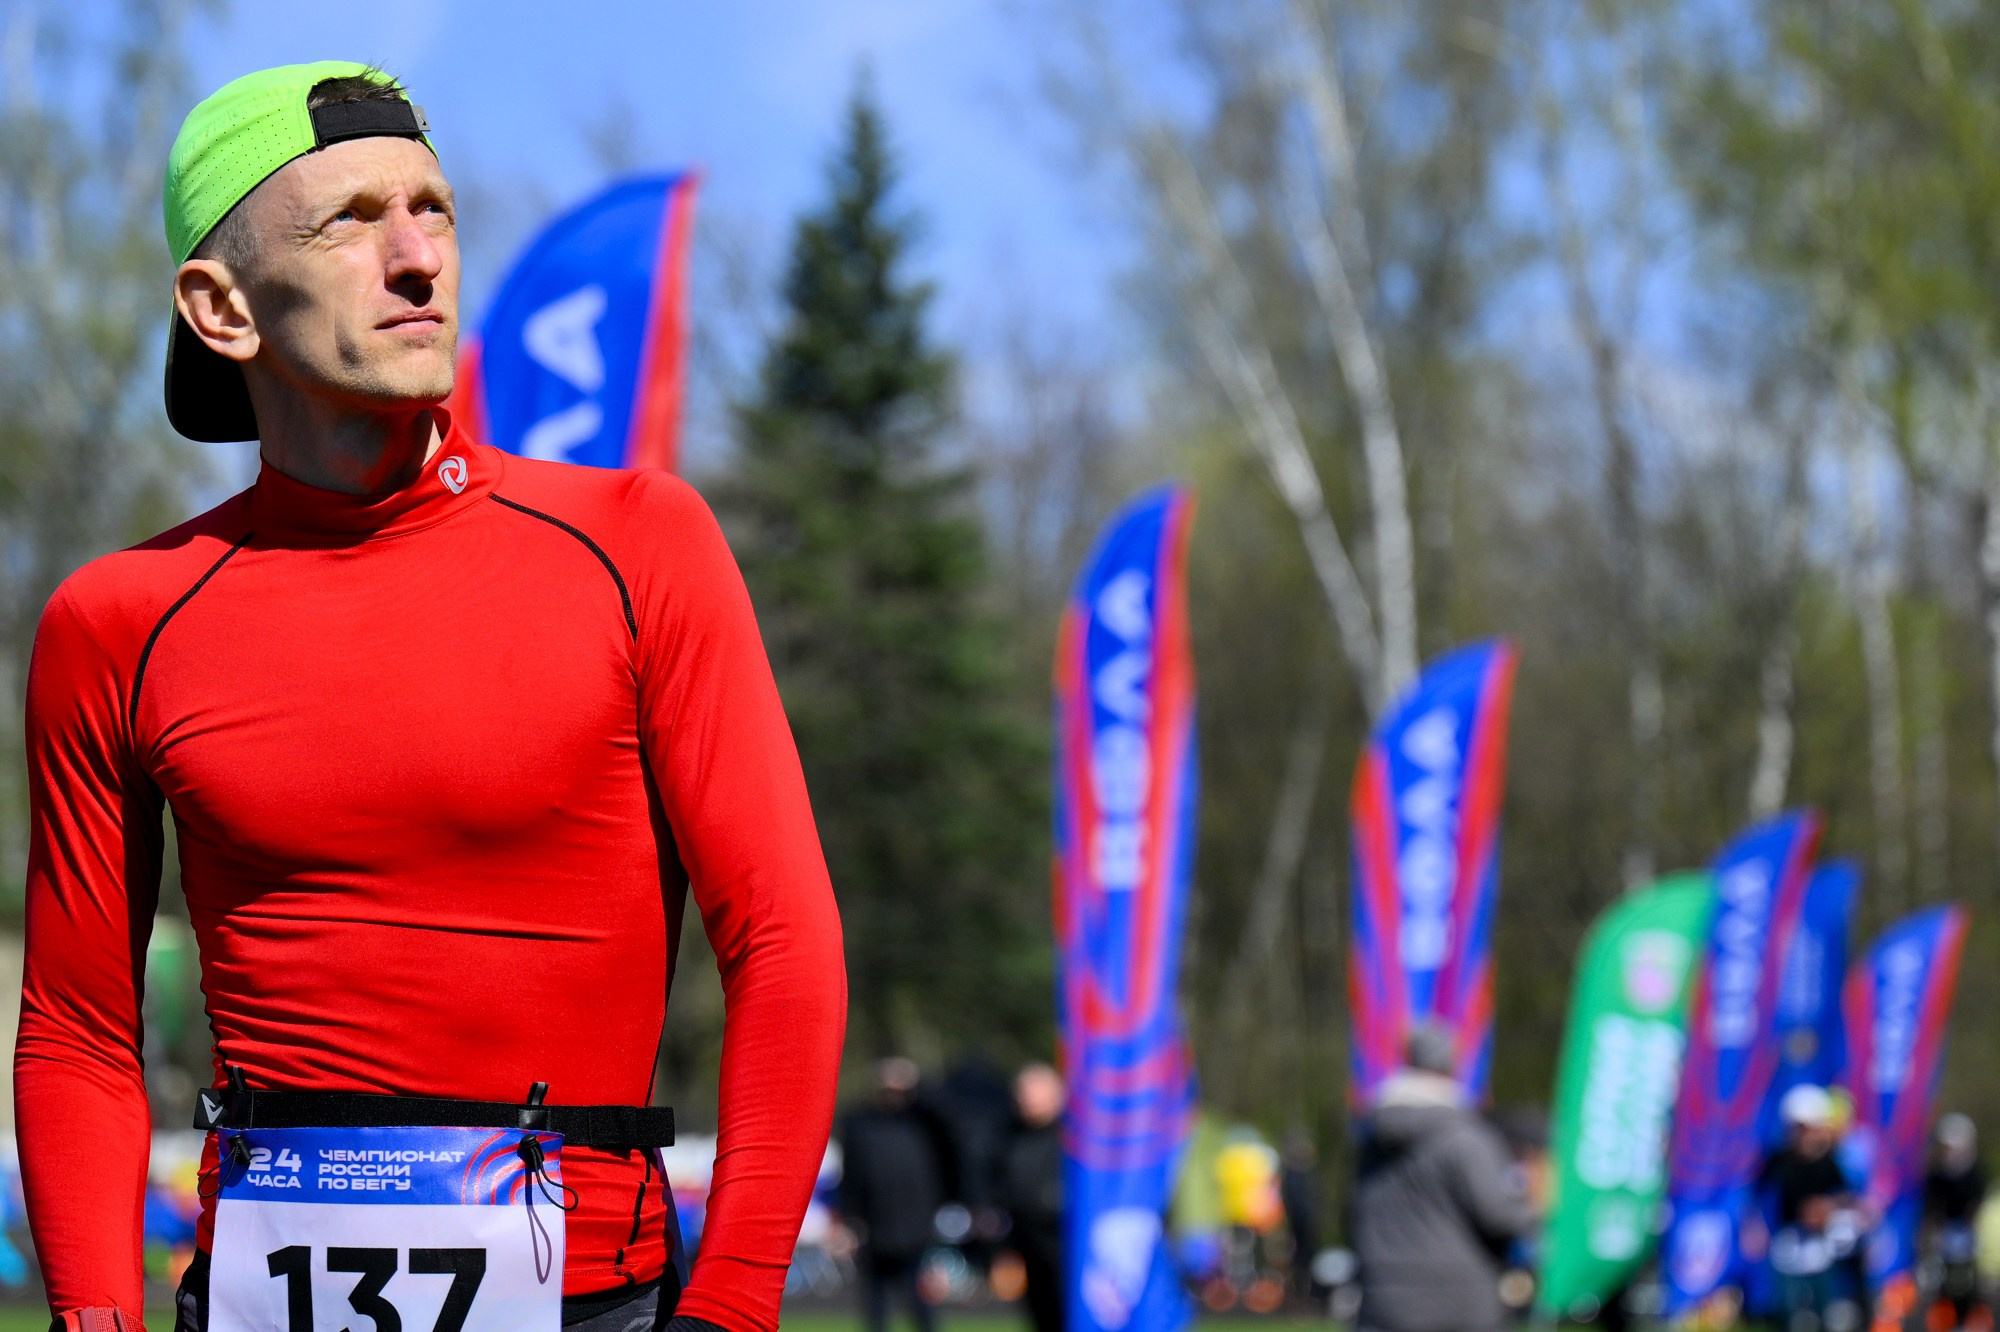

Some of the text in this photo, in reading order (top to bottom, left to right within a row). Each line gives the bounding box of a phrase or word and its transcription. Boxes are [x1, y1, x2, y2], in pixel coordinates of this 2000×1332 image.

[249, 1147, 302, 1173] 24
[319, 1149, 465, 1163] ЧЕМПИОНАТ
[318, 1163, 411, 1177] РОССИИ
[247, 1174, 302, 1189] ЧАСА
[318, 1178, 411, 1191] ПО БЕГУ
[267, 1245, 487, 1332] 137
